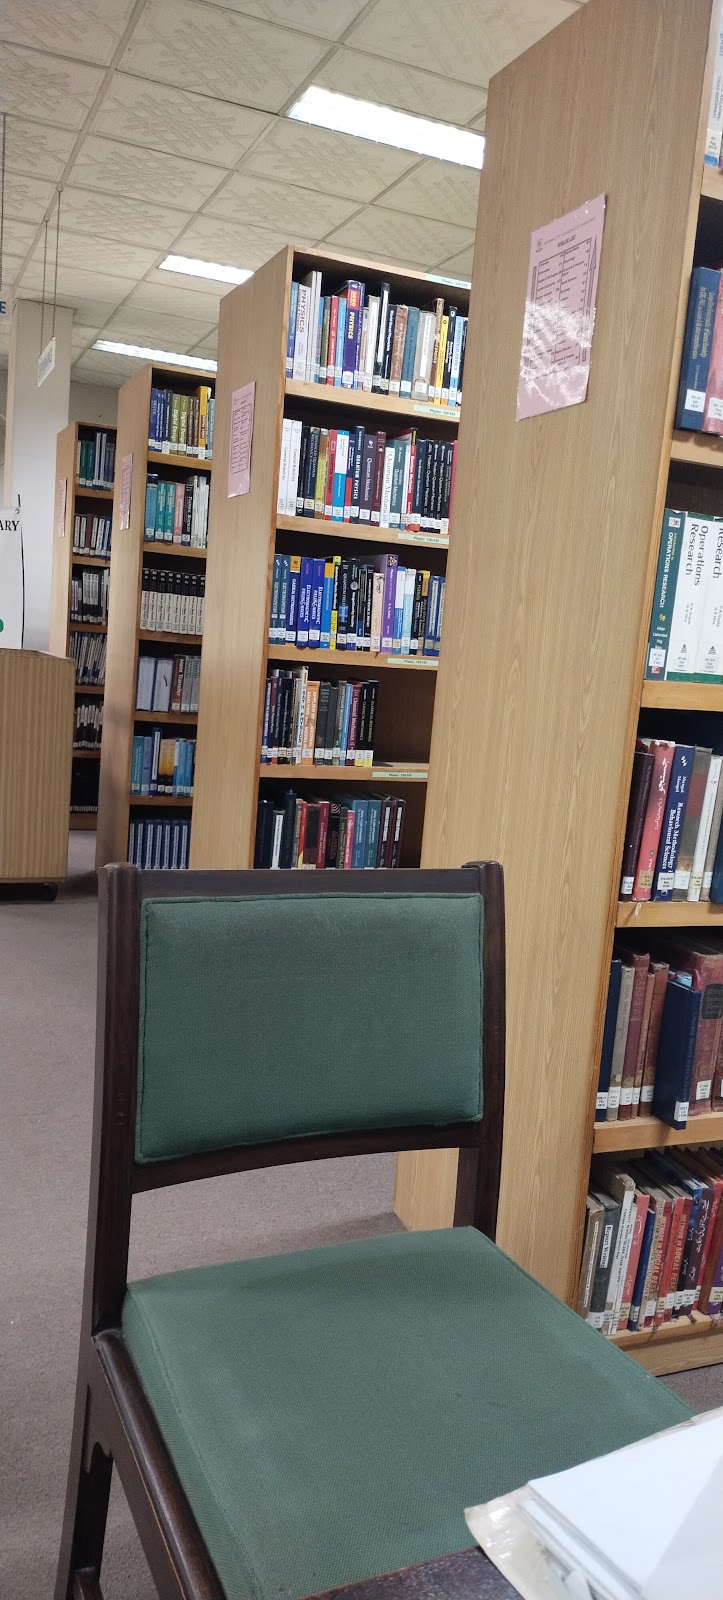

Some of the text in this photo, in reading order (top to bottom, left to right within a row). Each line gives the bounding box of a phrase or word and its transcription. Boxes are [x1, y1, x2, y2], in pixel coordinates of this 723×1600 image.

[686, 523, 698, 576] Research
[694, 525, 708, 586] Operations
[659, 533, 673, 608] OPERATIONS RESEARCH
[662, 809, 676, 870] Behavioural Sciences
[670, 830, 680, 869] Methodology
[658, 1216, 666, 1237] METHODS
[679, 1214, 687, 1238] METHODS
[653, 1246, 662, 1270] SOCIAL
[674, 1246, 683, 1270] SOCIAL
